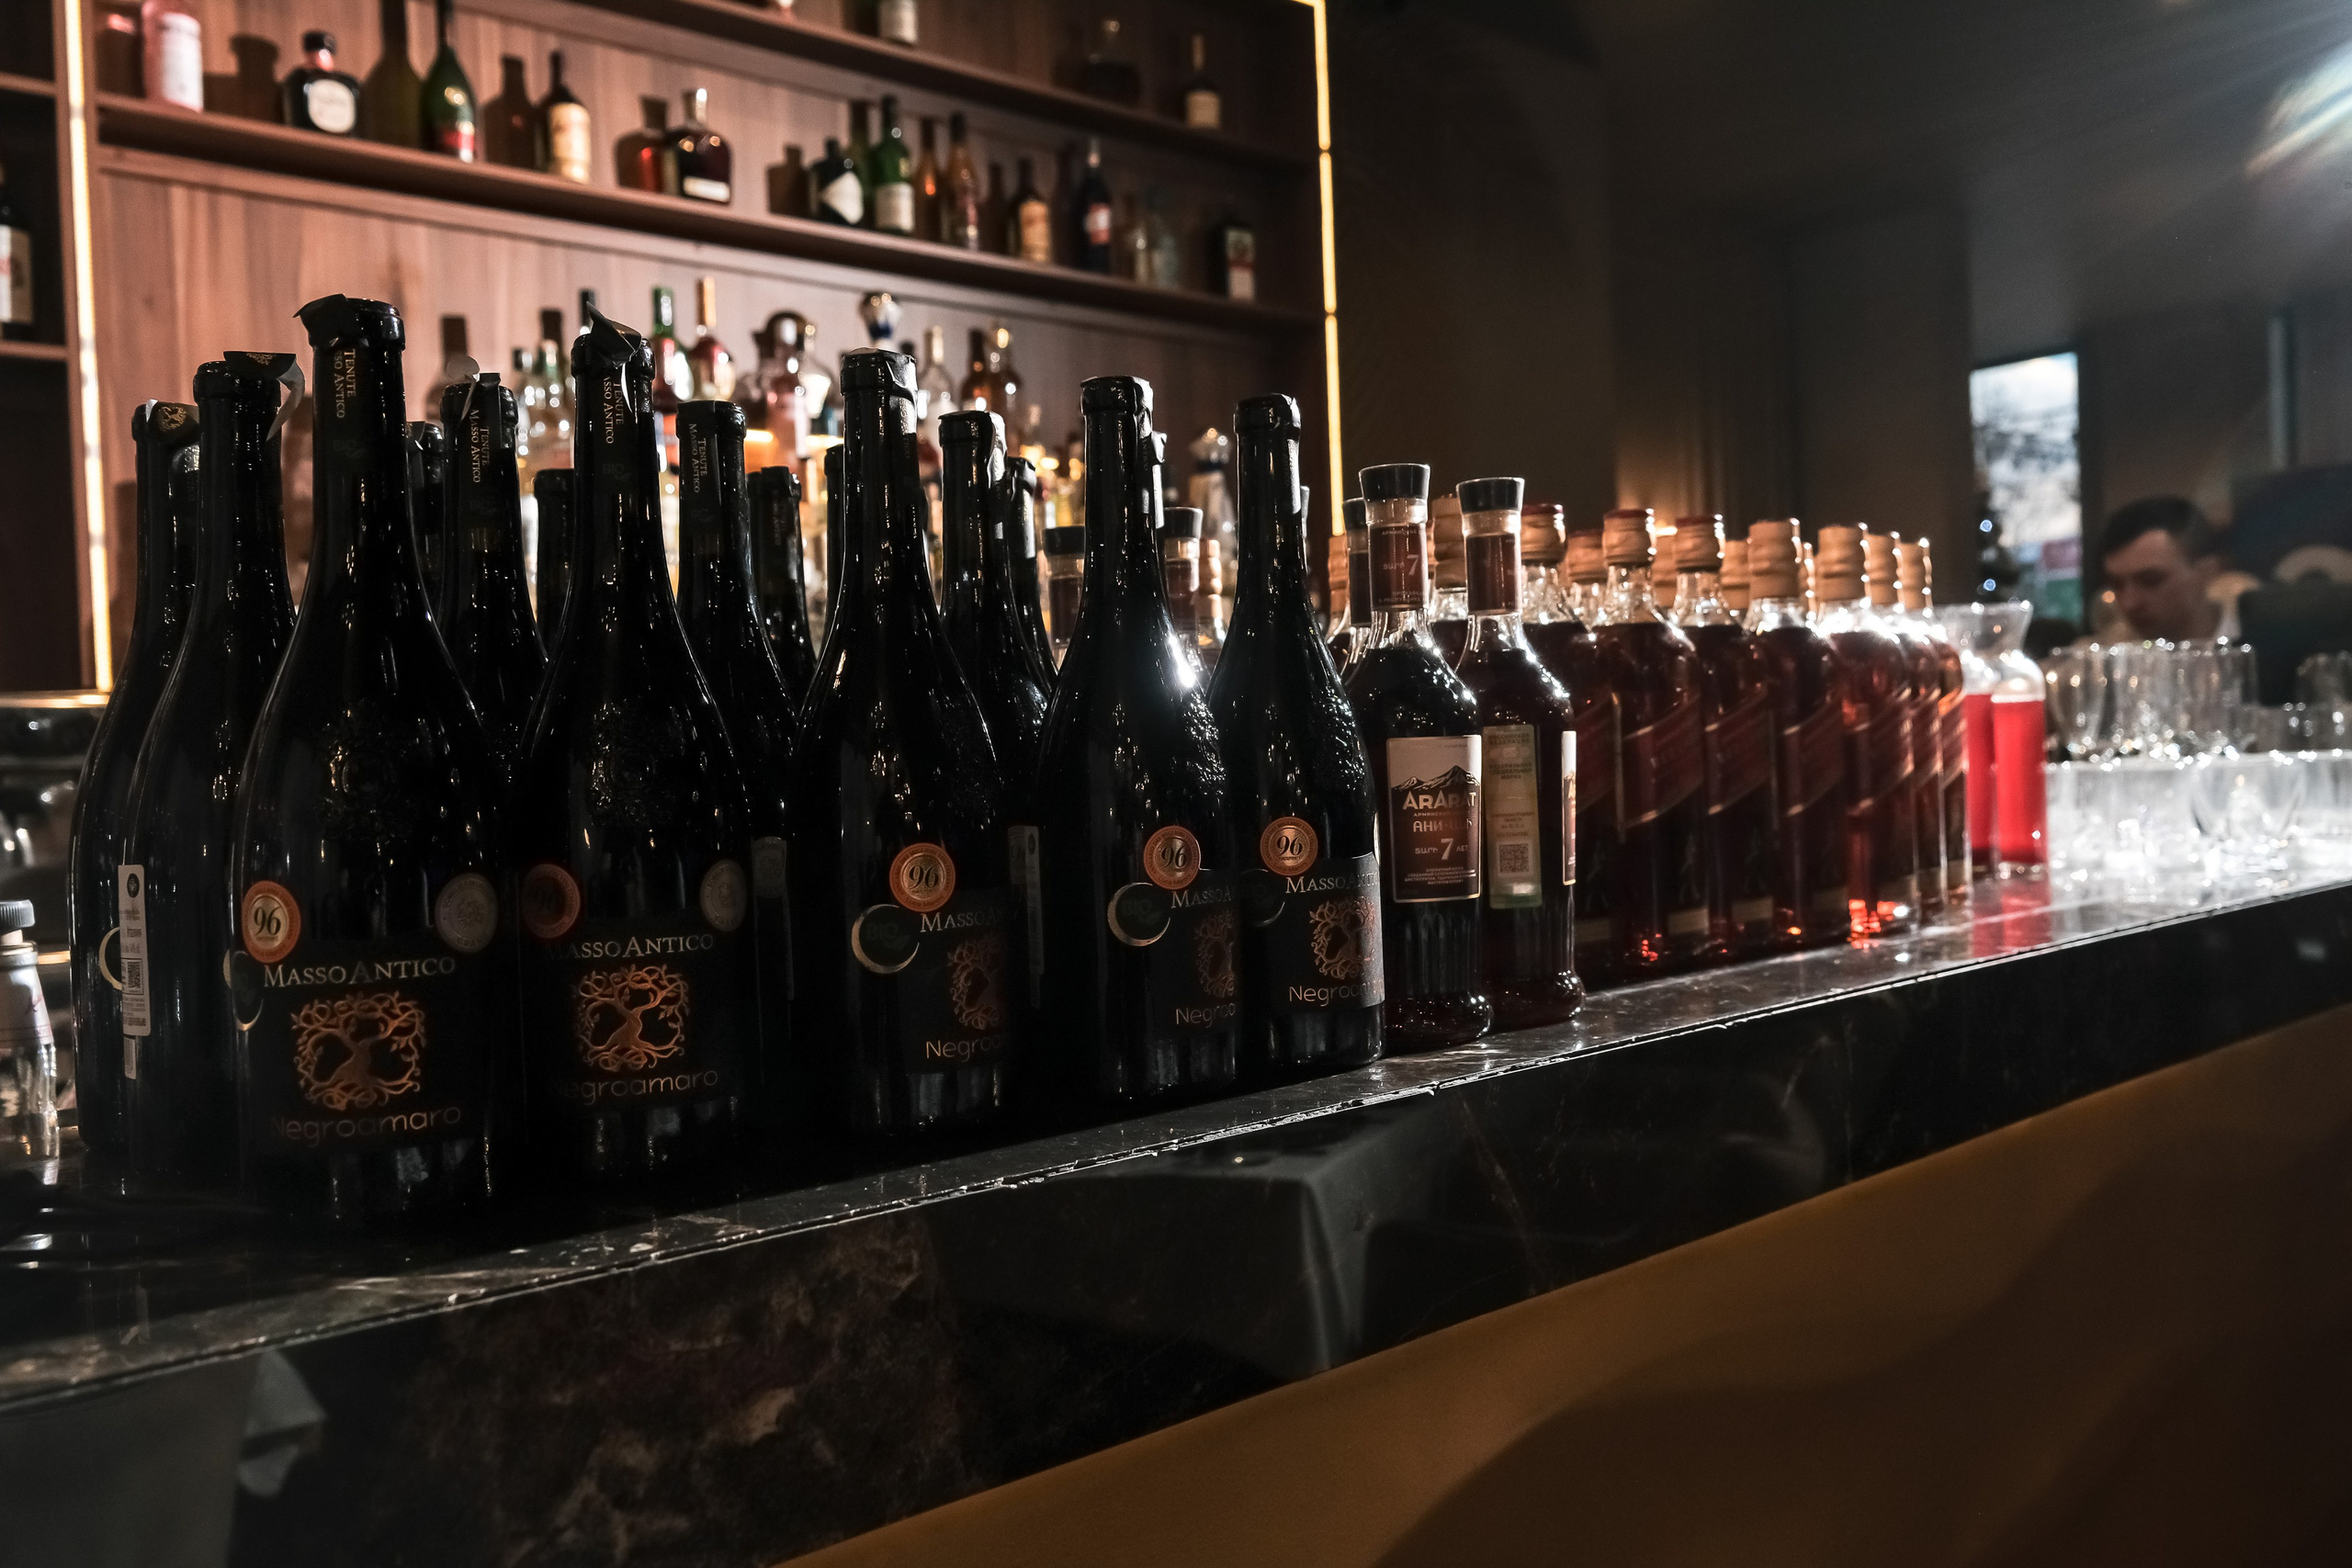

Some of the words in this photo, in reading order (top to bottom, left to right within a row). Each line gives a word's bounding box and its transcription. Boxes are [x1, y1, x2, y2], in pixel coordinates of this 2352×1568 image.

[334, 350, 344, 369] SSO
[344, 349, 356, 397] TENUTE
[334, 373, 345, 419] ANTICO
[603, 377, 613, 400] ASSO
[613, 382, 625, 425] TENUTE
[469, 409, 480, 443] MASSO
[604, 402, 614, 445] ANTICO
[480, 426, 491, 466] TENUTE
[689, 423, 697, 456] MASSO
[471, 446, 481, 483] ANTICO
[698, 438, 707, 477] TENUTE
[692, 458, 700, 493] ANTICO
[1407, 554, 1419, 576] 7
[1402, 789, 1476, 810] ARARAT
[1412, 820, 1443, 833] АНИ
[1160, 846, 1187, 869] 96
[1276, 835, 1303, 856] 96
[1441, 838, 1454, 861] 7
[909, 864, 939, 890] 96
[1171, 884, 1233, 908] MASSOA
[254, 907, 281, 936] 96
[546, 934, 714, 961] ASSOANTICO
